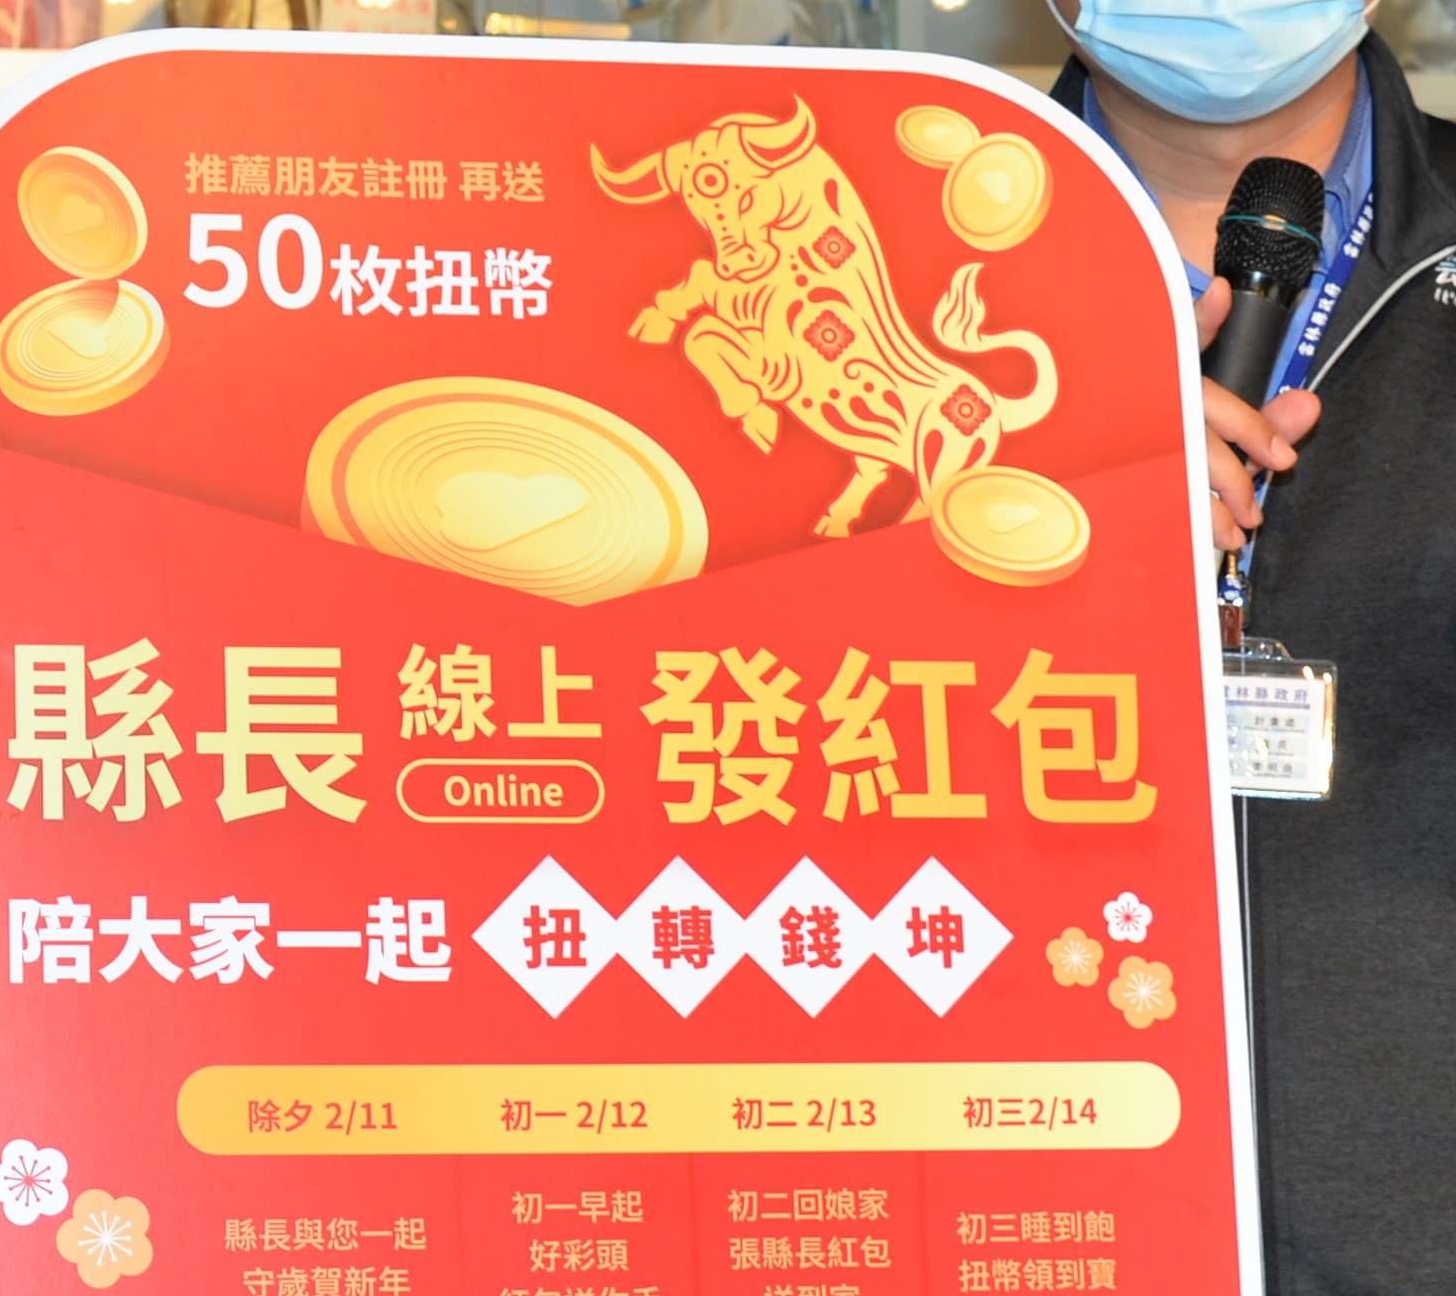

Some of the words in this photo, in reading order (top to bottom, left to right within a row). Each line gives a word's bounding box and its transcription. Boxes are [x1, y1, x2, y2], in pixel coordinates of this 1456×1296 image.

[184, 152, 448, 200] 推薦朋友註冊
[458, 161, 545, 202] 再送
[183, 213, 553, 320] 50枚扭幣
[6, 637, 367, 823] 縣長
[397, 643, 602, 742] 線上
[639, 646, 1158, 826] 發紅包
[444, 773, 564, 807] Online
[8, 895, 452, 985] 陪大家一起
[522, 904, 964, 967] 扭轉錢坤
[247, 1098, 313, 1133] 除夕
[325, 1100, 398, 1136] 2/11
[500, 1098, 567, 1132] 初一
[576, 1099, 648, 1135] 2/12
[732, 1097, 798, 1131] 初二
[806, 1097, 877, 1133] 2/13
[511, 1189, 644, 1225] 初一早起
[727, 1187, 889, 1222] 初二回娘家
[224, 1217, 427, 1252] 縣長與您一起
[956, 1210, 1116, 1245] 初三睡到飽
[529, 1238, 629, 1273] 好彩頭
[729, 1235, 892, 1271] 張縣長紅包
[958, 1257, 1117, 1293] 扭幣領到寶
